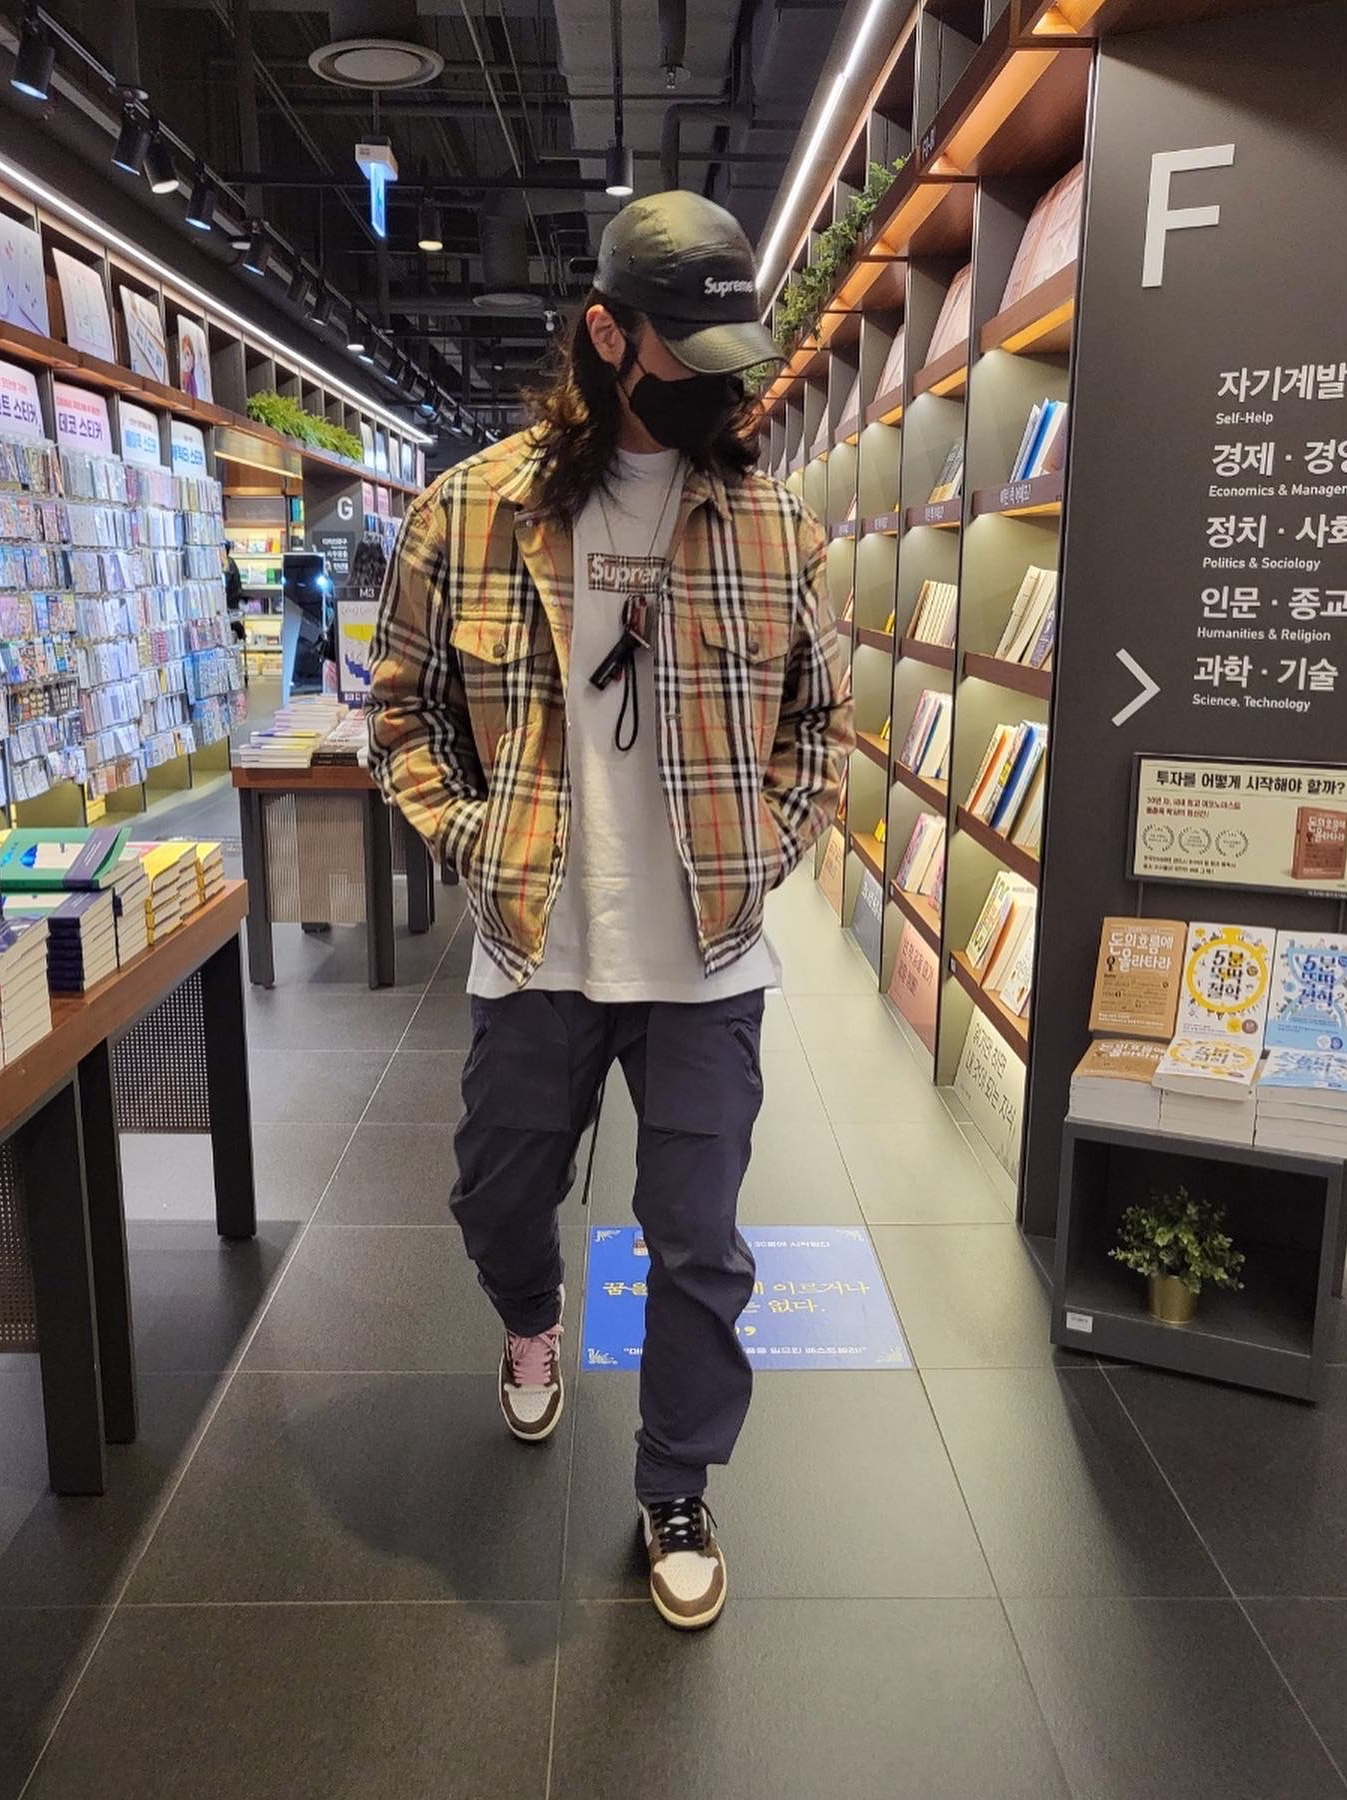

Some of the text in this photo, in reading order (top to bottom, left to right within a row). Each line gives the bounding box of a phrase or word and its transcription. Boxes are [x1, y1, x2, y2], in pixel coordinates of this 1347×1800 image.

[1142, 144, 1235, 288] F
[704, 276, 754, 298] Supreme
[1216, 361, 1347, 402] 자기계발
[14, 398, 38, 425] 스티커
[1215, 410, 1274, 425] Self-Help
[80, 416, 103, 441] 스티커
[1212, 442, 1275, 477] 경제
[1209, 485, 1275, 497] Economics
[1278, 484, 1288, 496] &
[337, 496, 354, 521] G
[1205, 514, 1267, 549] 정치
[1202, 557, 1321, 572] Politics & Sociology
[1201, 585, 1261, 619] 인문
[1288, 587, 1347, 620] 종교
[1197, 626, 1332, 643] Humanities & Religion
[1193, 655, 1254, 688] 과학
[1277, 657, 1340, 692] 기술
[1243, 695, 1312, 713] Technology
[1157, 770, 1346, 796] 투자를 어떻게 시작해야 할까?
[768, 1298, 826, 1314] 없다.
